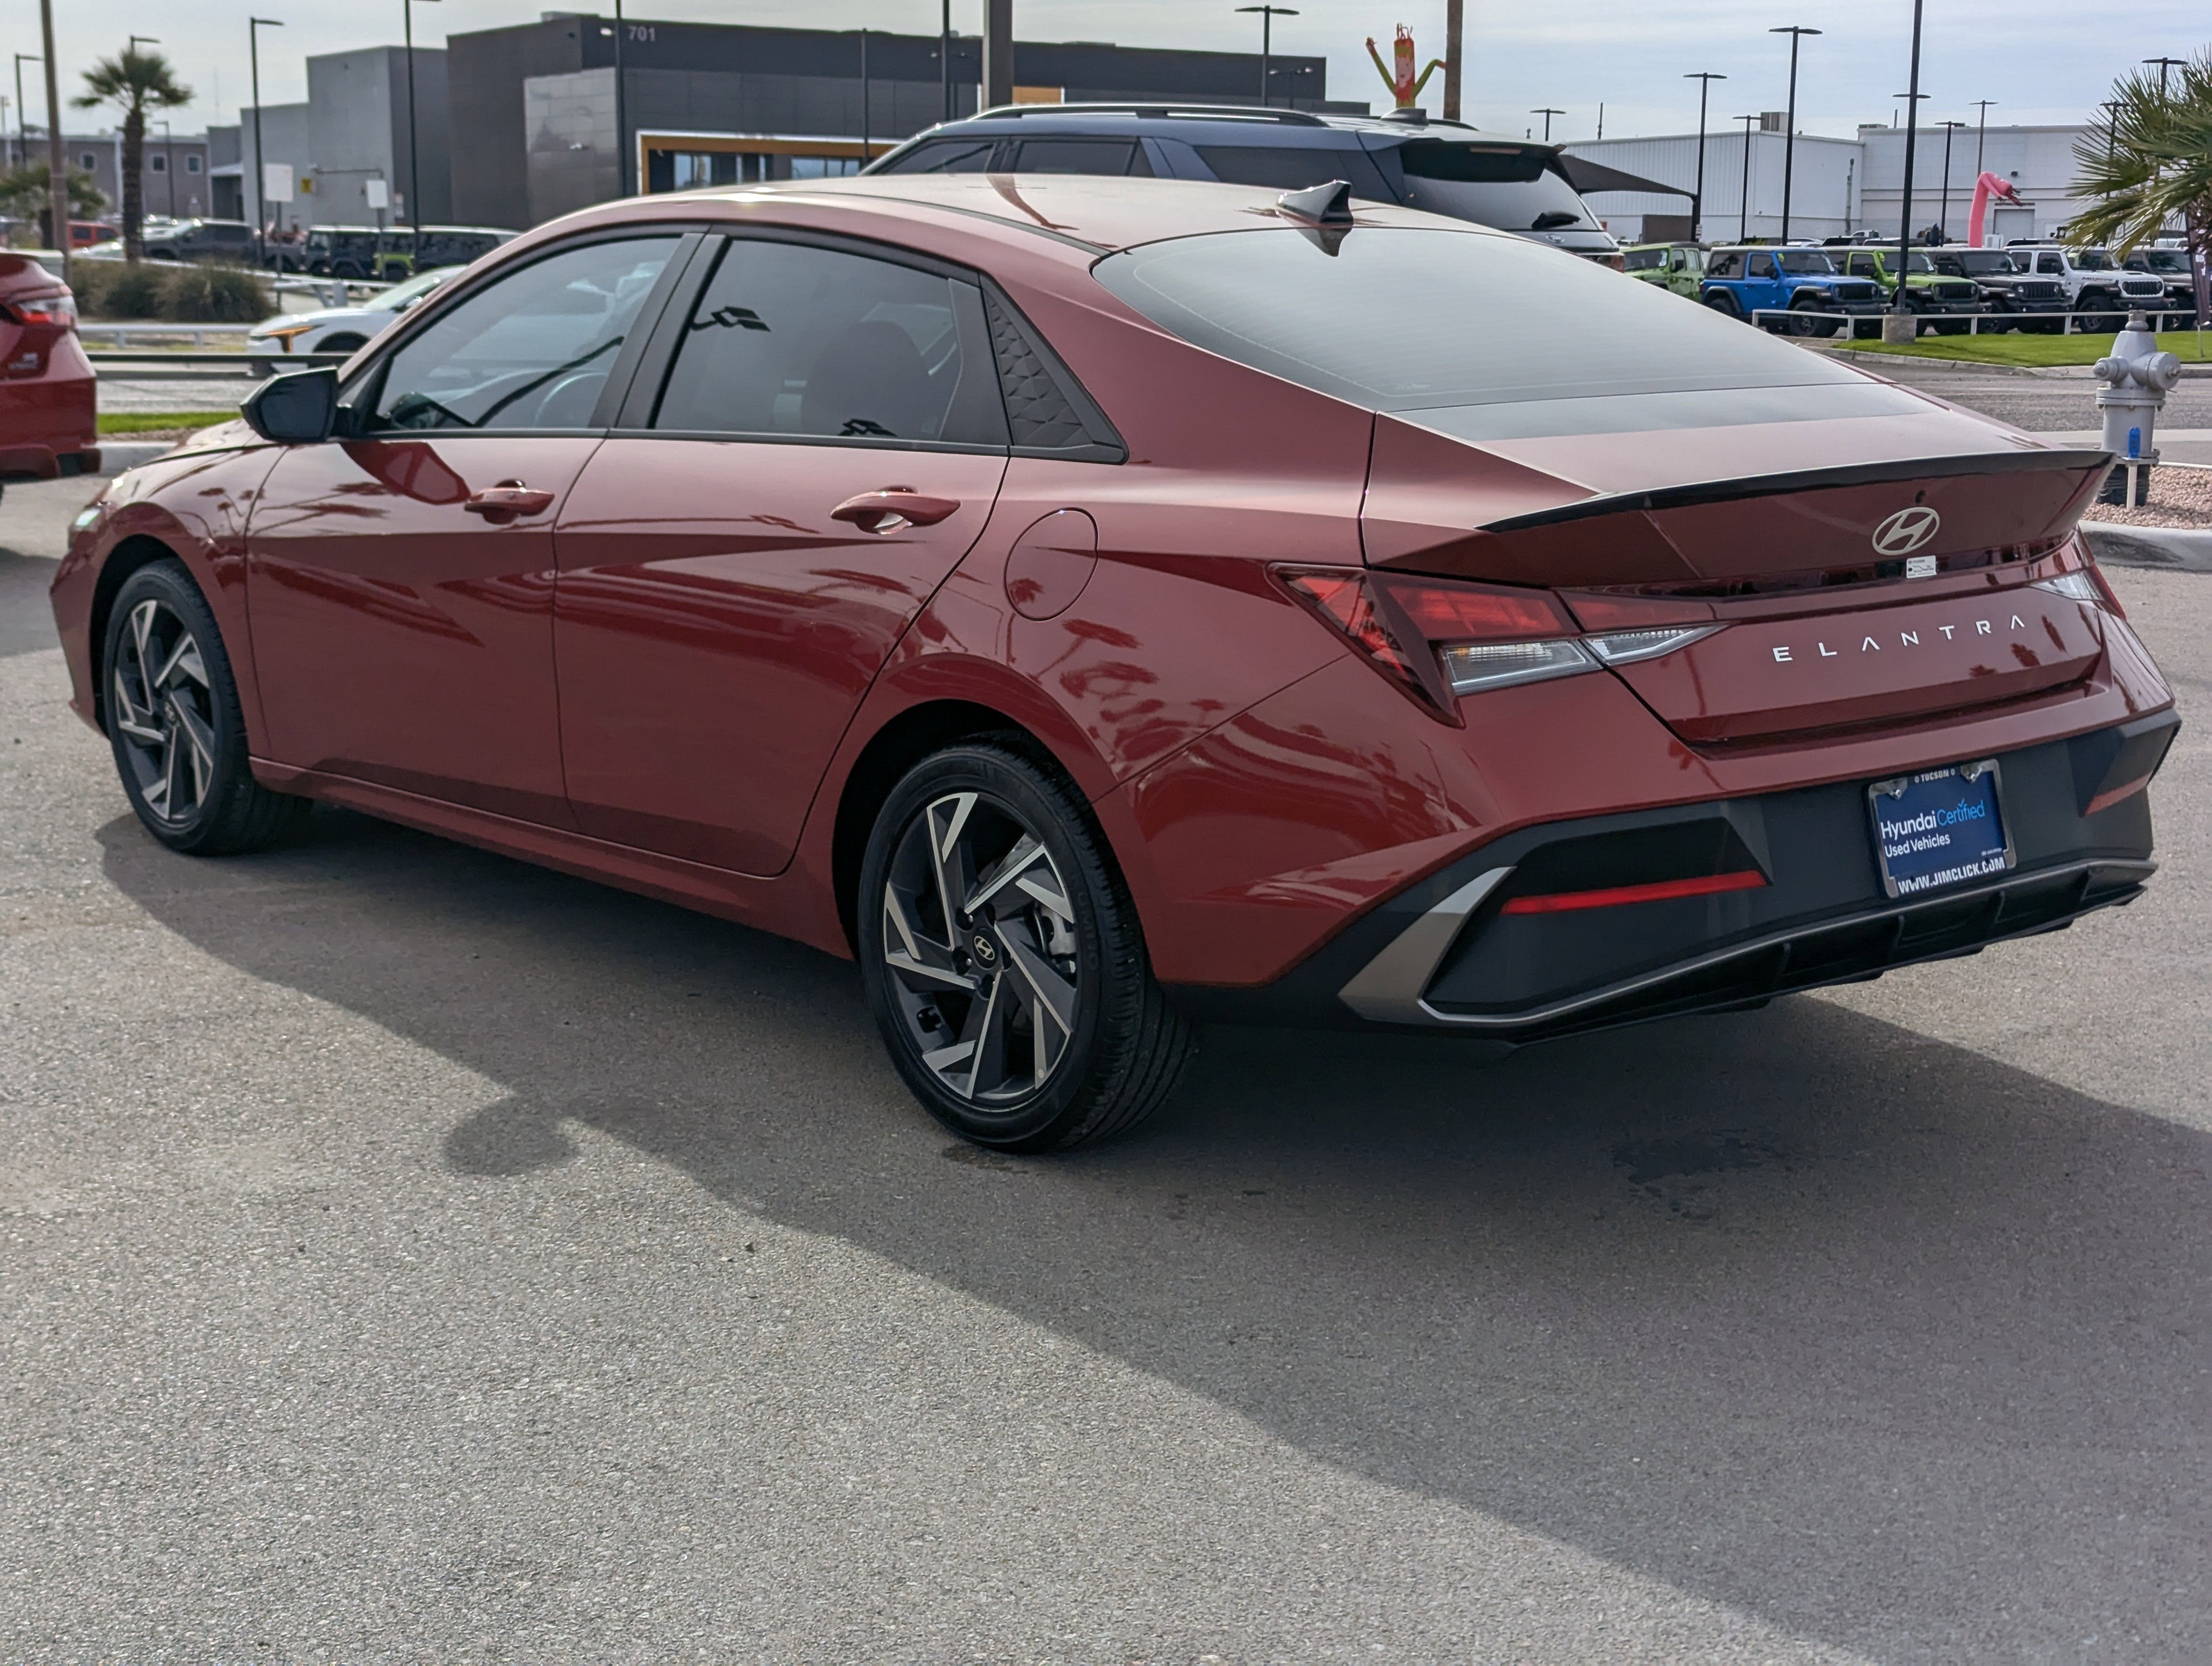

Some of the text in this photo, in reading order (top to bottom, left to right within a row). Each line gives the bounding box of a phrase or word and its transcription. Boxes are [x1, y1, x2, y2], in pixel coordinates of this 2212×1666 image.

[628, 25, 655, 42] 701
[1772, 614, 2025, 662] ELANTRA
[1921, 769, 1949, 782] TUCSON
[1880, 799, 1985, 841] Hyundai Certified
[1885, 833, 1951, 858] Used Vehicles
[1898, 856, 2005, 894] WWW.JIMCLICK.COM
